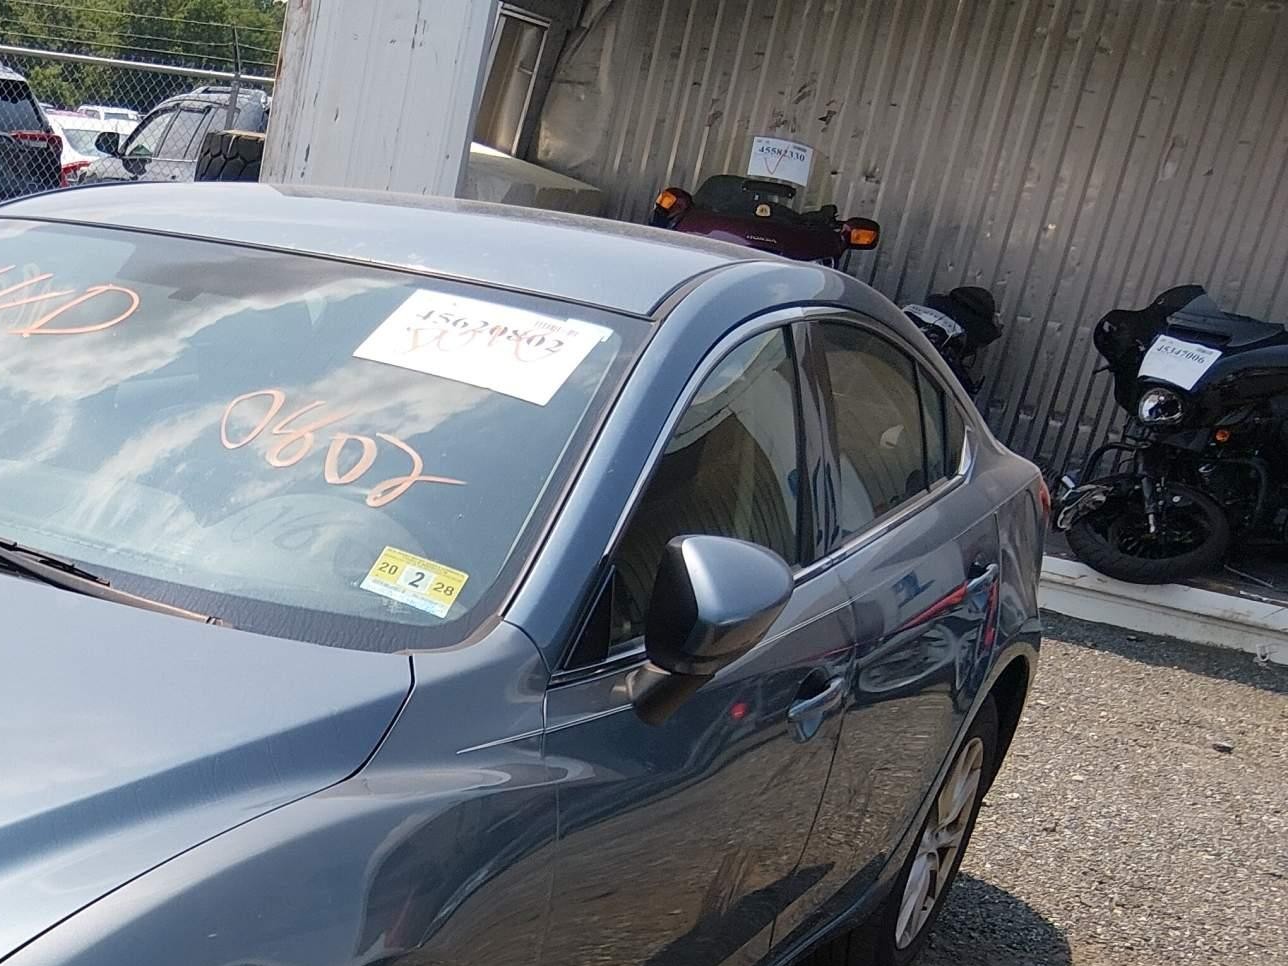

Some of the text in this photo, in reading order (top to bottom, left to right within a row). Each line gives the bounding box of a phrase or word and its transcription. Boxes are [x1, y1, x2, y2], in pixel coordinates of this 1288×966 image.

[416, 309, 564, 353] 45620802
[220, 388, 468, 508] 0802
[378, 561, 400, 576] 20
[408, 571, 426, 588] 2
[433, 582, 455, 597] 28
